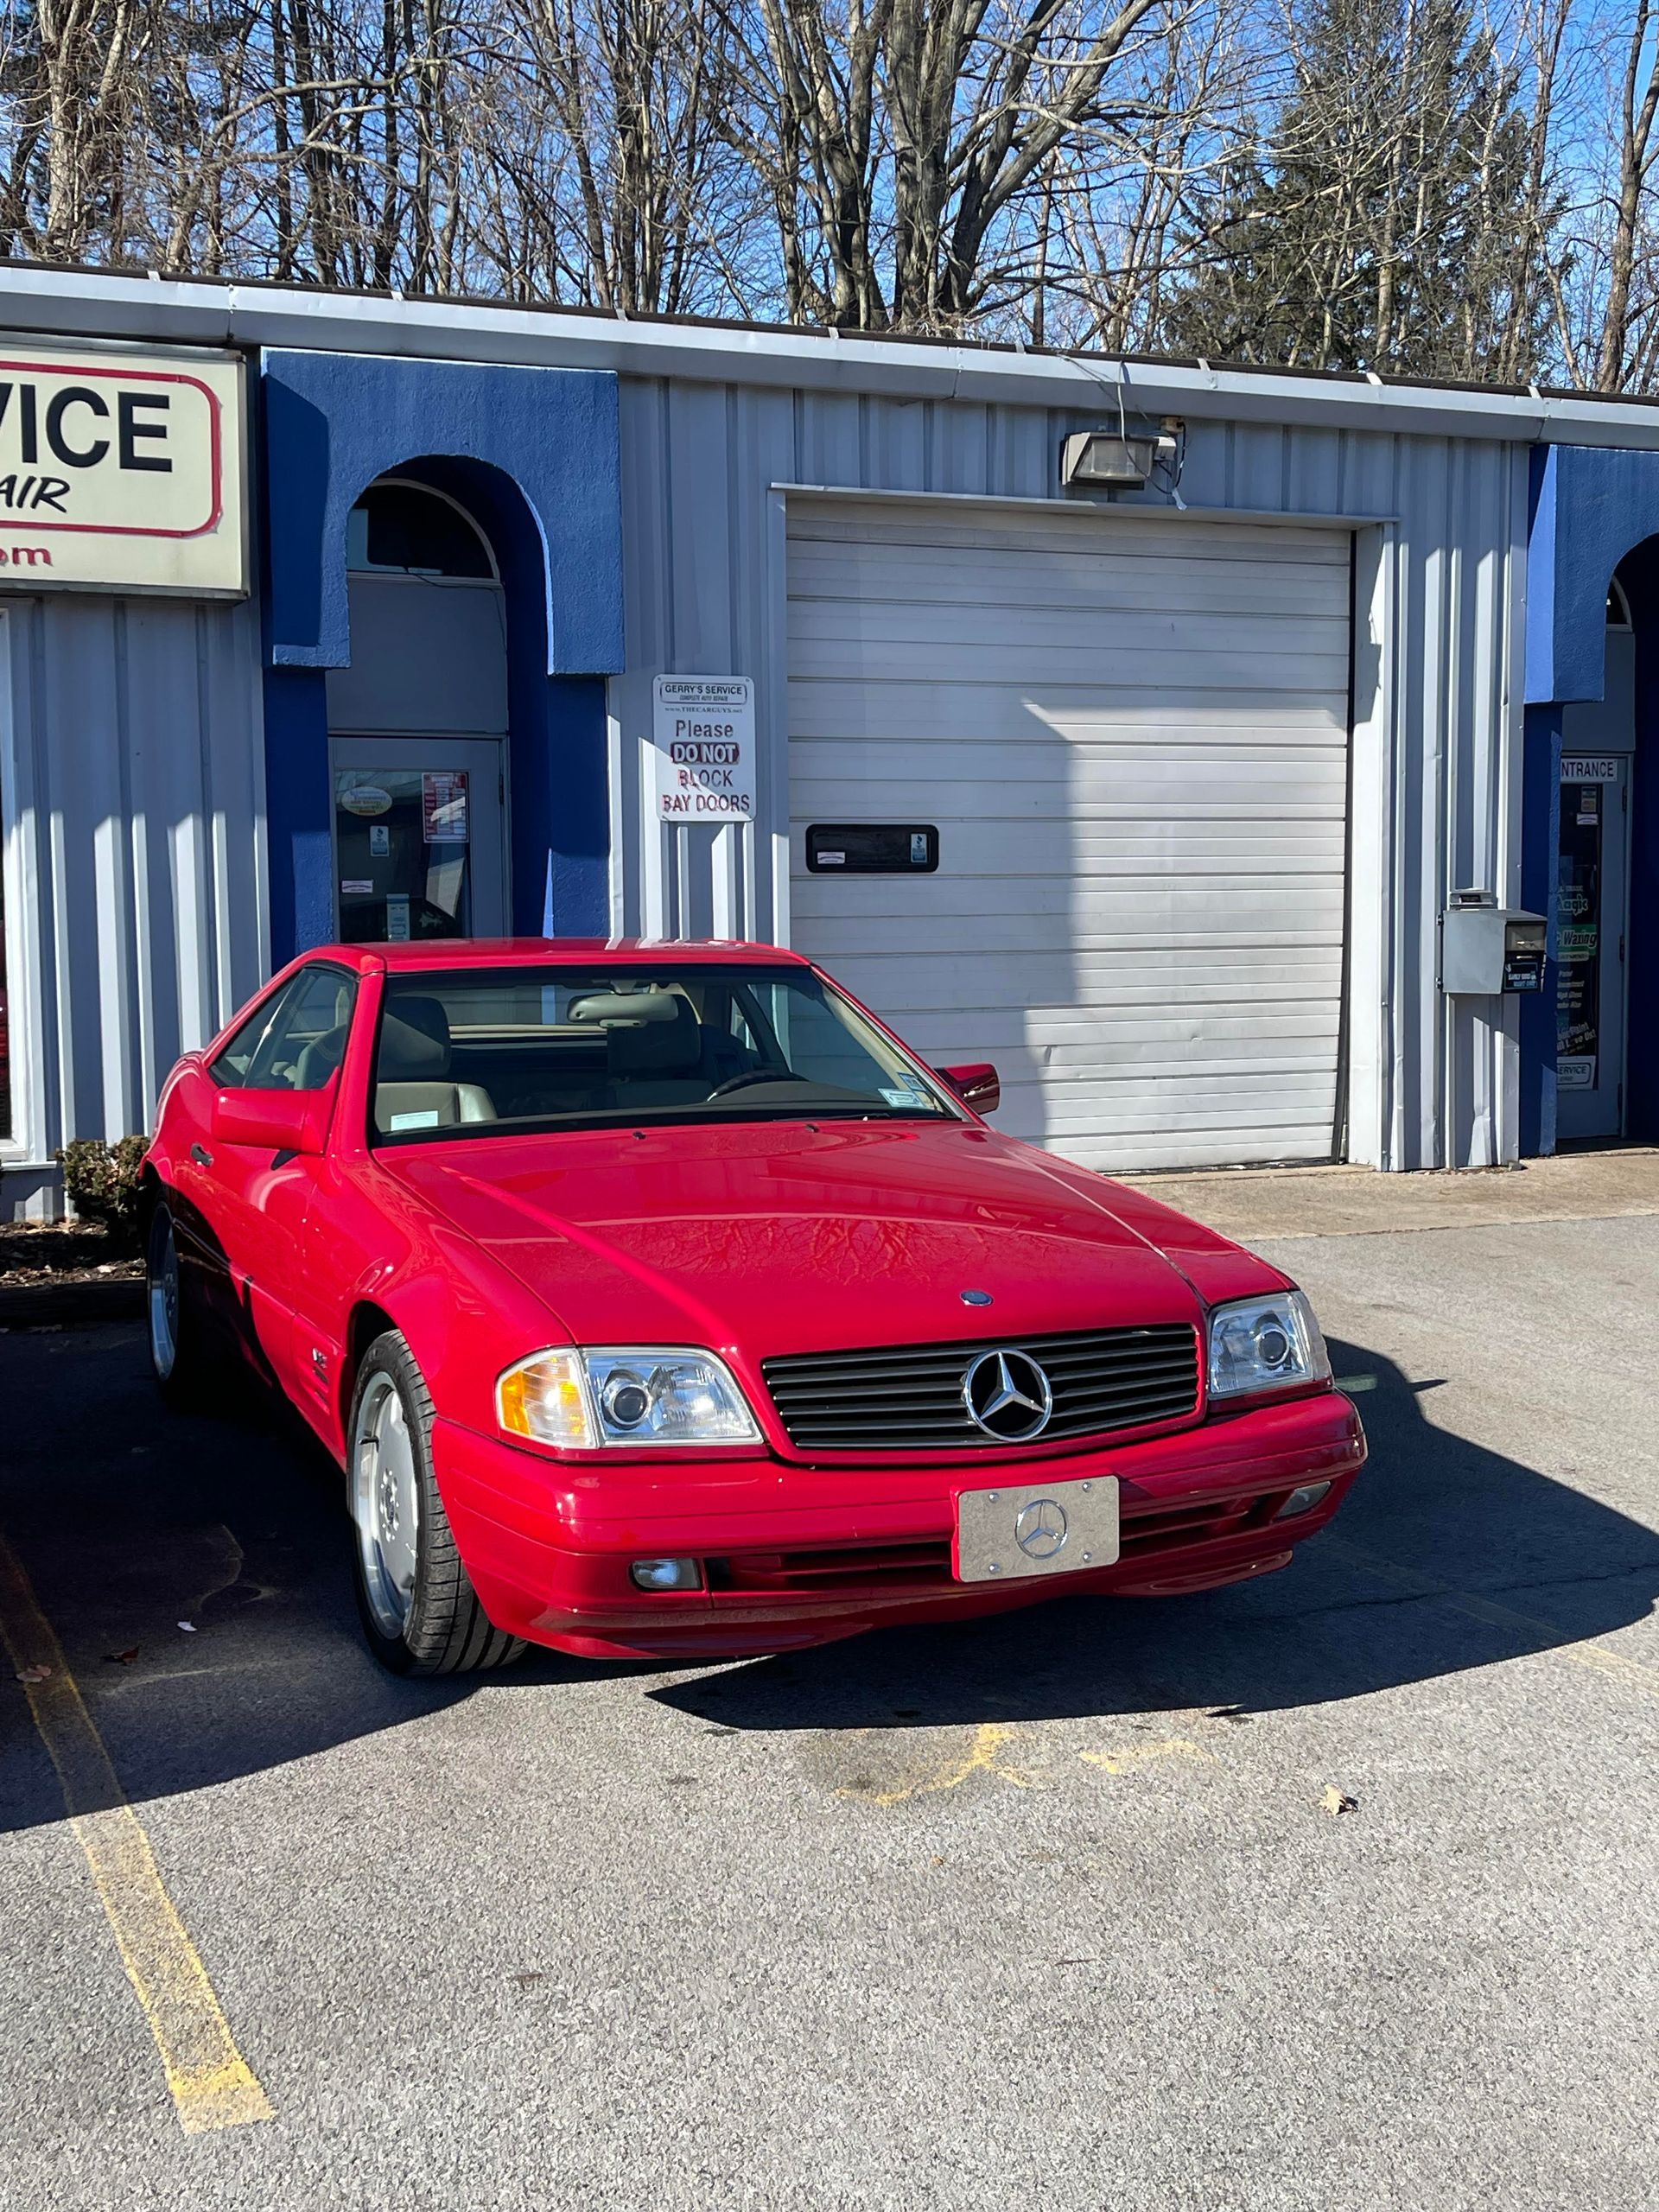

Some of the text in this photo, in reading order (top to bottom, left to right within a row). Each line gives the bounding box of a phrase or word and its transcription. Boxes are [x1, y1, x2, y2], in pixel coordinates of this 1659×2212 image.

[0, 382, 173, 473] ICE
[0, 474, 71, 513] AIR
[664, 683, 743, 696] GERRY'S SERVICE
[676, 719, 734, 738] Please
[674, 743, 736, 763] DO NOT
[678, 769, 734, 788] BLOCK
[662, 794, 750, 812] BAY DOORS
[1563, 930, 1598, 949] Waxing
